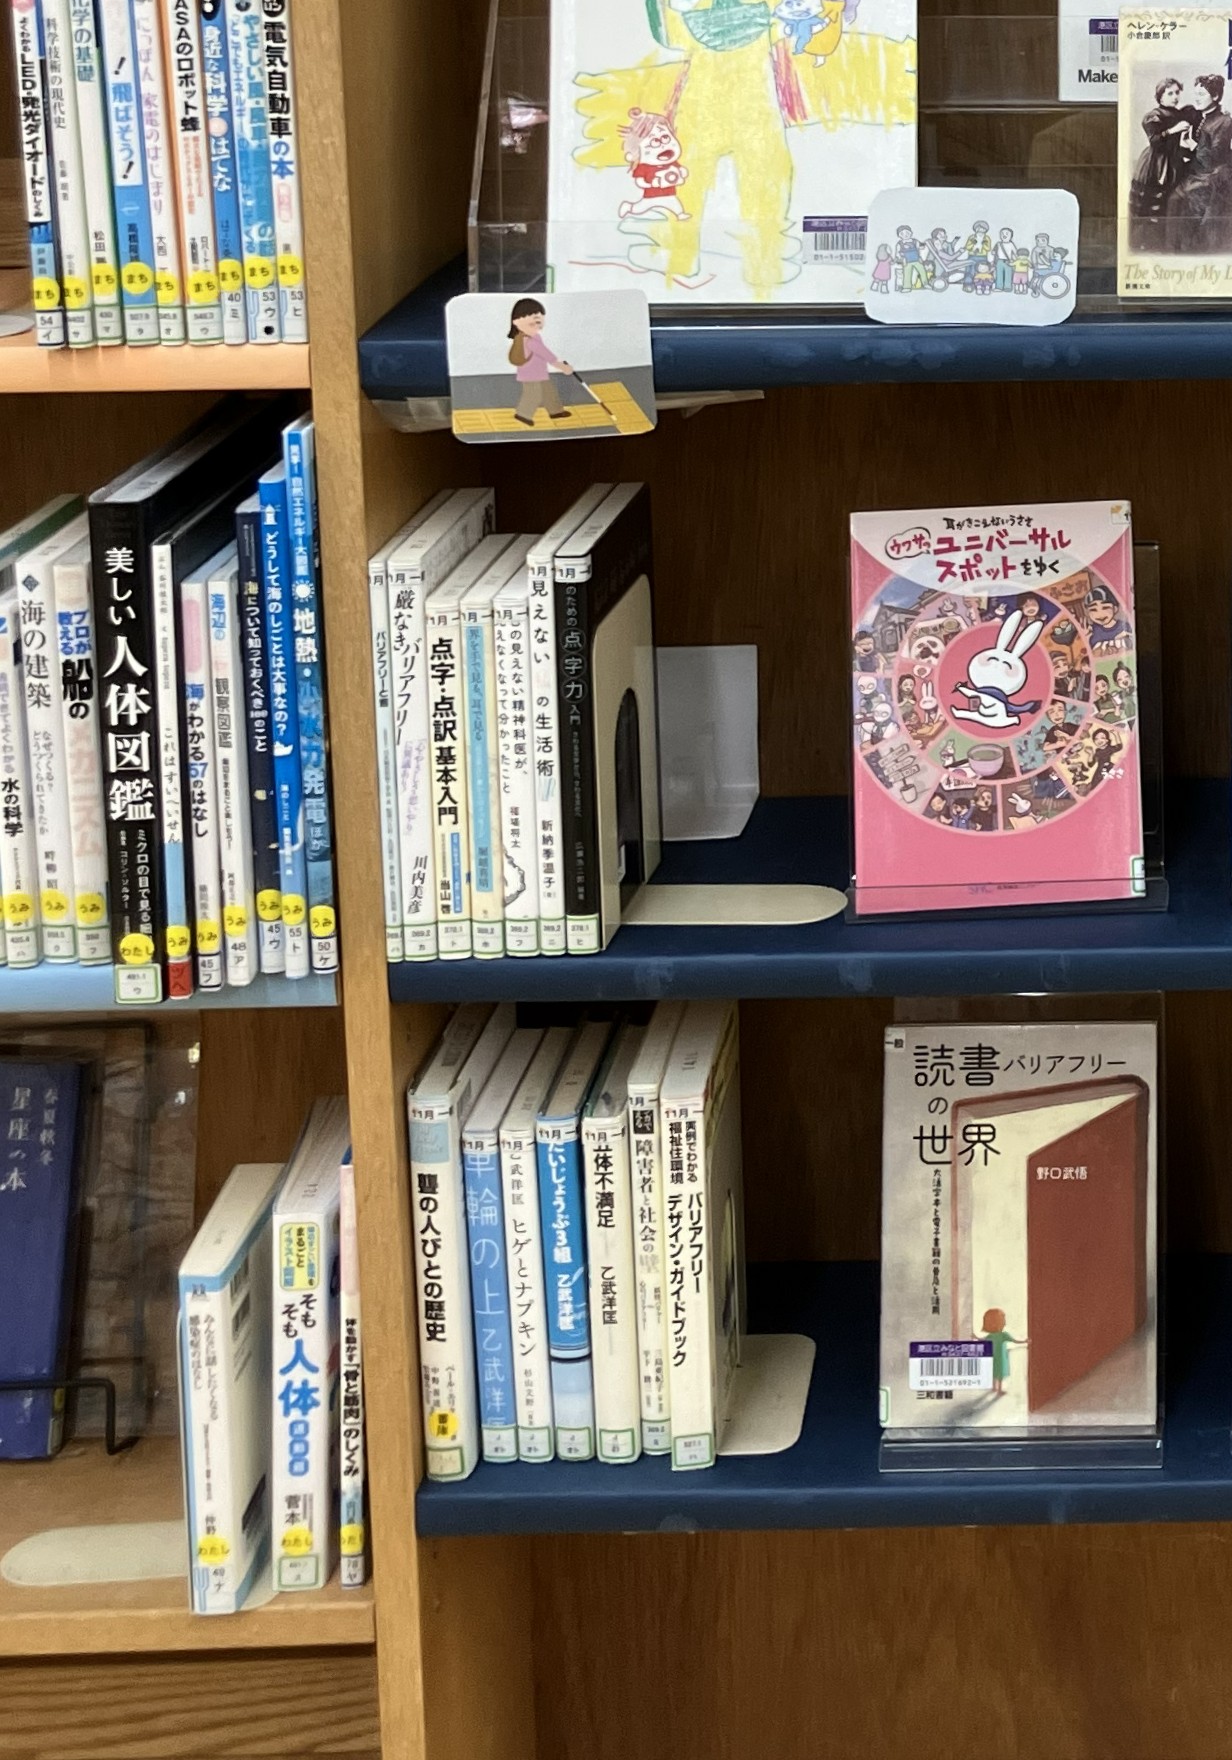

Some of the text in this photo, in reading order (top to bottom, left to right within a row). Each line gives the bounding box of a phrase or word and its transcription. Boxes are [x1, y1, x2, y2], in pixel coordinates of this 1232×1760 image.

[264, 22, 295, 179] 電気自動車の本
[1124, 264, 1148, 281] The
[1152, 264, 1184, 283] Story
[1201, 264, 1222, 284] My
[933, 527, 1071, 555] ユニバーサル
[936, 553, 1060, 583] スポットをゆく
[21, 600, 51, 709] 海の建築
[101, 546, 156, 821] 美しい人体図鑑
[531, 580, 555, 776] 見えない の生活術
[435, 746, 459, 826] 基本入門
[913, 1123, 1001, 1166] 世界
[928, 1097, 949, 1116] の
[1036, 1166, 1088, 1181] 野口武悟
[417, 1172, 447, 1342] 聾の人びとの歴史
[667, 1193, 687, 1367] デザイン・ガイドブック
[687, 1192, 704, 1294] バリアフリー
[512, 1219, 537, 1356] ヒゲとナプキン
[600, 1266, 618, 1325] 乙武洋匡
[278, 1338, 322, 1418] 人体
